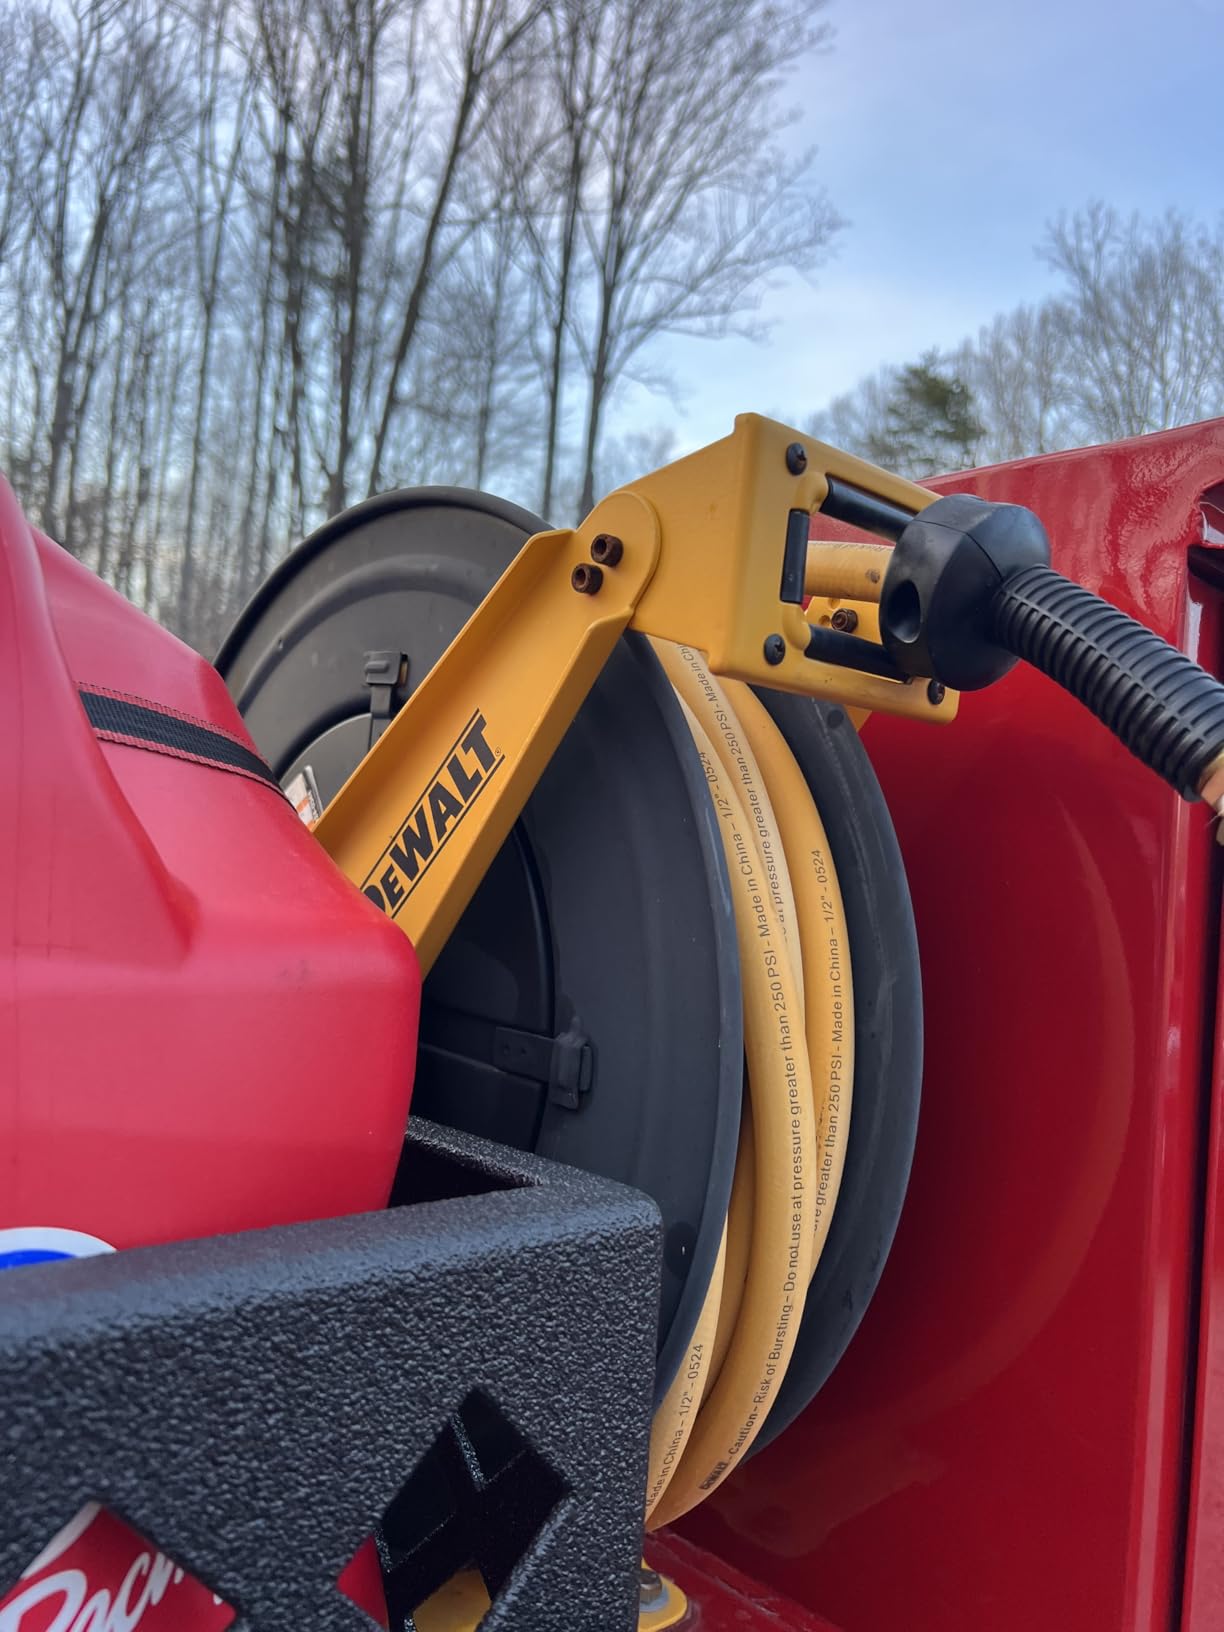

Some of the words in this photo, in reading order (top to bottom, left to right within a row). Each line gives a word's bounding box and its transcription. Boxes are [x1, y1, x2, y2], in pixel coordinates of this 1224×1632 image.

[698, 673, 718, 702] Made
[714, 710, 731, 731] PSI
[725, 732, 742, 756] 250
[699, 752, 718, 783] 0524
[736, 757, 752, 785] than
[747, 788, 770, 838] greater
[733, 833, 753, 876] China
[811, 850, 827, 884] 0524
[747, 879, 759, 892] in
[762, 842, 784, 904] pressure
[752, 895, 771, 937] Made
[763, 950, 780, 978] PSI
[829, 939, 841, 981] China
[770, 982, 786, 1011] 250
[832, 985, 841, 998] in
[779, 1015, 792, 1051] than
[832, 1002, 843, 1042] Made
[831, 1055, 842, 1081] PSI
[784, 1056, 801, 1115] greater
[828, 1084, 841, 1112] 250
[824, 1116, 837, 1148] than
[791, 1119, 805, 1190] pressure
[816, 1152, 833, 1206] greater
[790, 1194, 802, 1209] at
[792, 1213, 801, 1240] use
[789, 1240, 800, 1268] not
[784, 1271, 797, 1292] Do
[768, 1304, 794, 1360] Bursting
[766, 1364, 777, 1376] of
[663, 1429, 684, 1465] China
[688, 1344, 703, 1379] 0524
[754, 1379, 772, 1404] Risk
[728, 1412, 758, 1455] Caution
